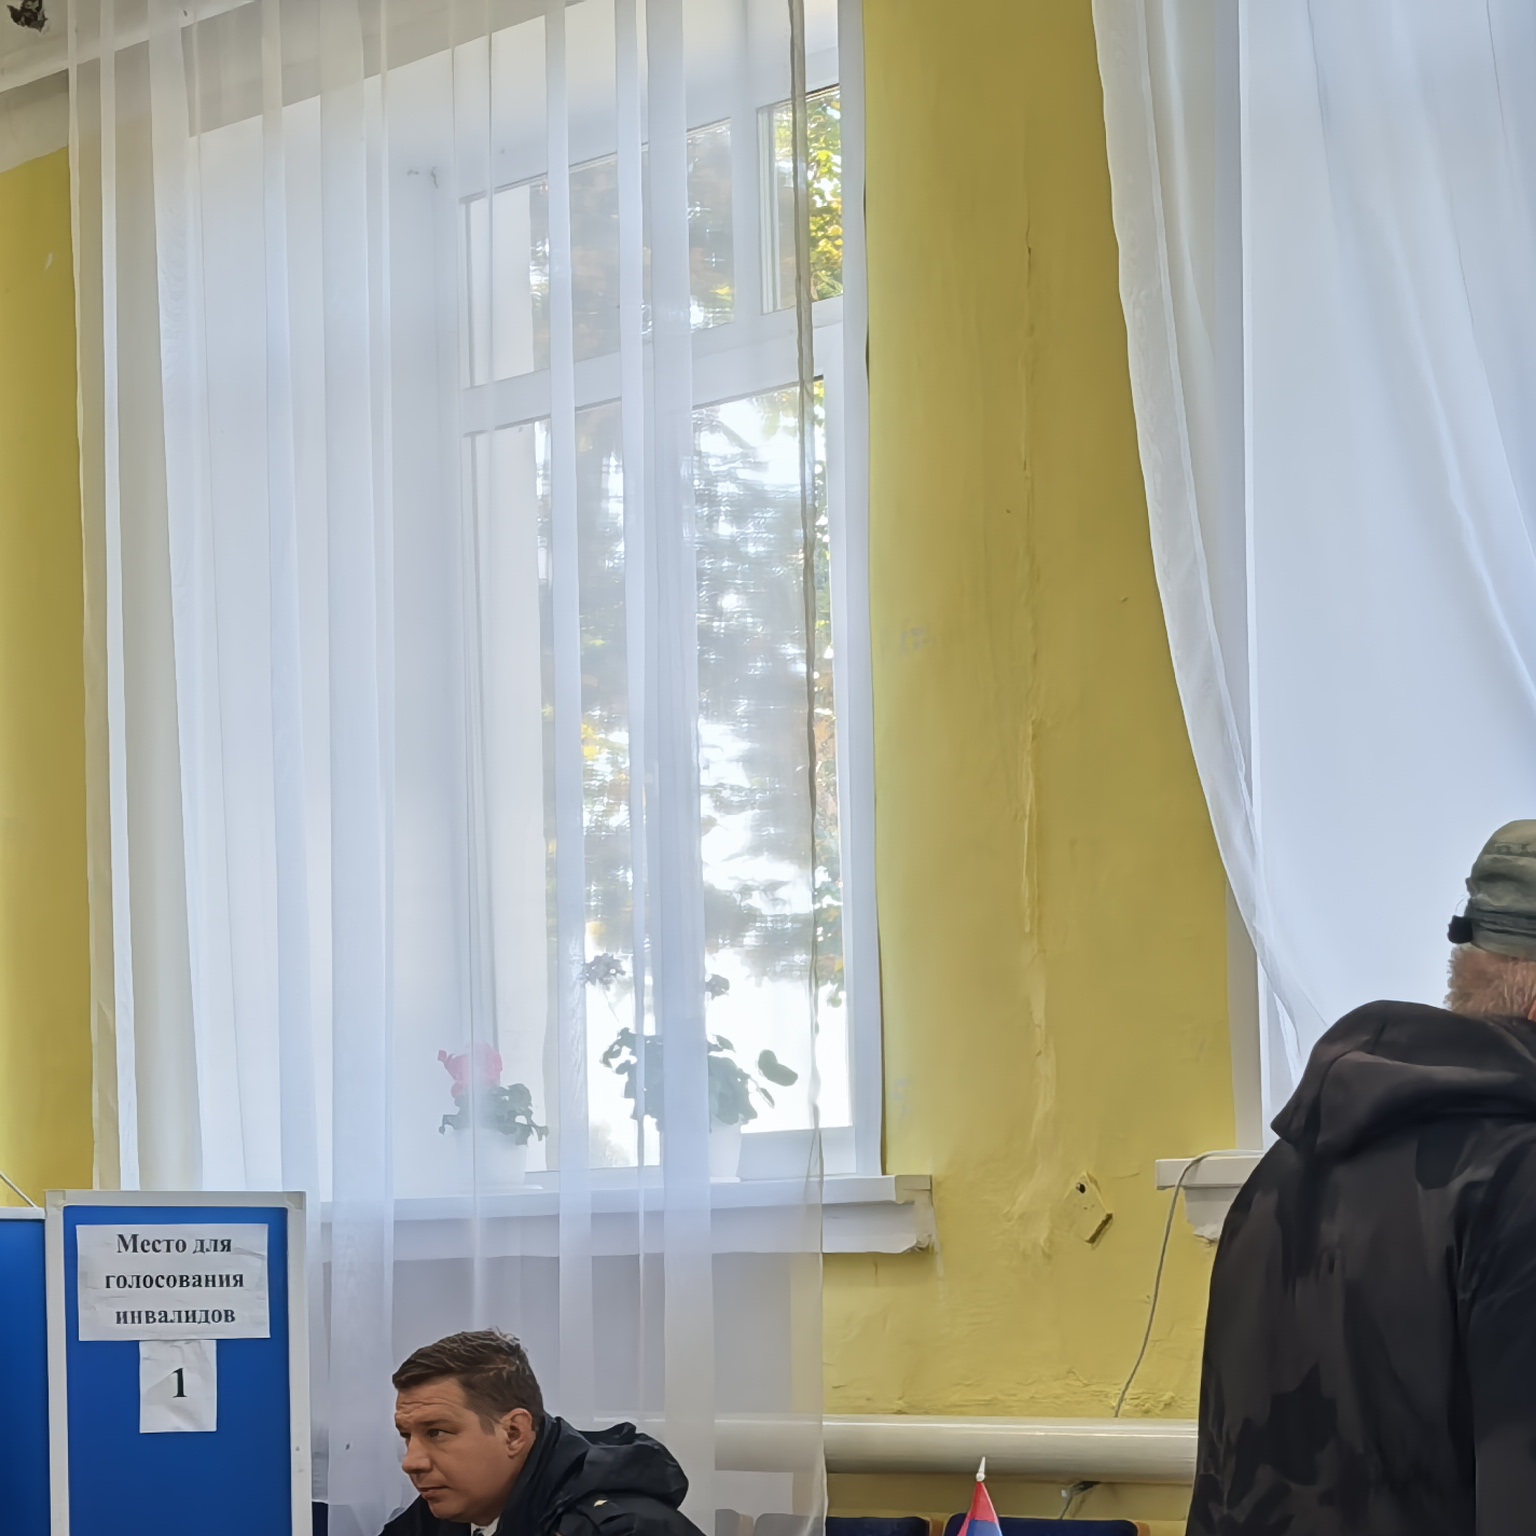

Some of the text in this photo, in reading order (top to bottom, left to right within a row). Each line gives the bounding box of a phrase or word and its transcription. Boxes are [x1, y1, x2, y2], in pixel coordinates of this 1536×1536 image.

[116, 1233, 233, 1254] Место для
[105, 1273, 245, 1289] голосования
[115, 1308, 237, 1325] инвалидов
[172, 1367, 188, 1399] 1
